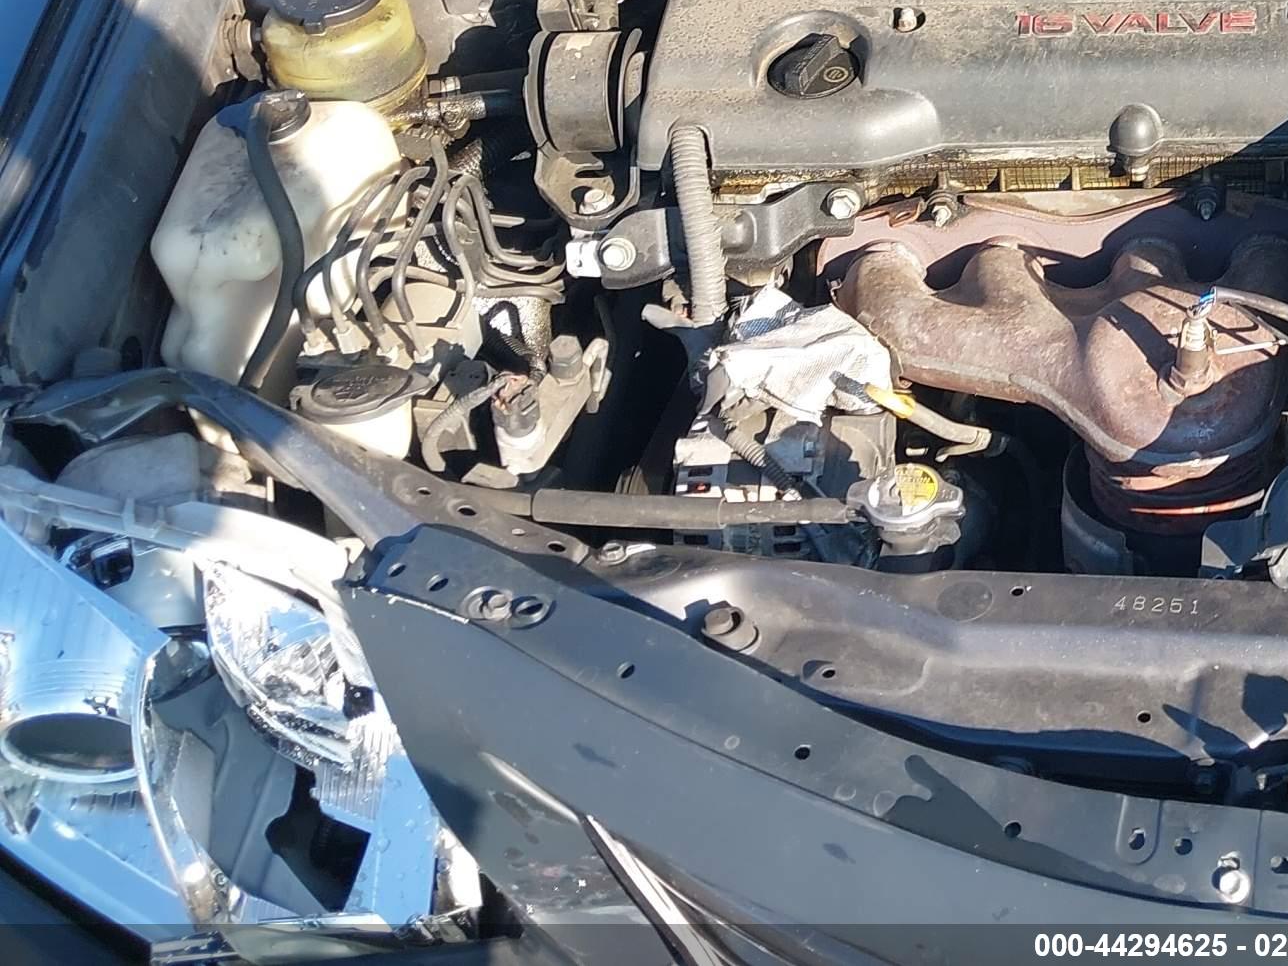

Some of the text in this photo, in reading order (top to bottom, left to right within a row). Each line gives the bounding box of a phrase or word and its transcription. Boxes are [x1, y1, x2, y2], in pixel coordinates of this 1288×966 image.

[1016, 11, 1258, 38] 16 VALVE
[1114, 595, 1200, 615] 48251
